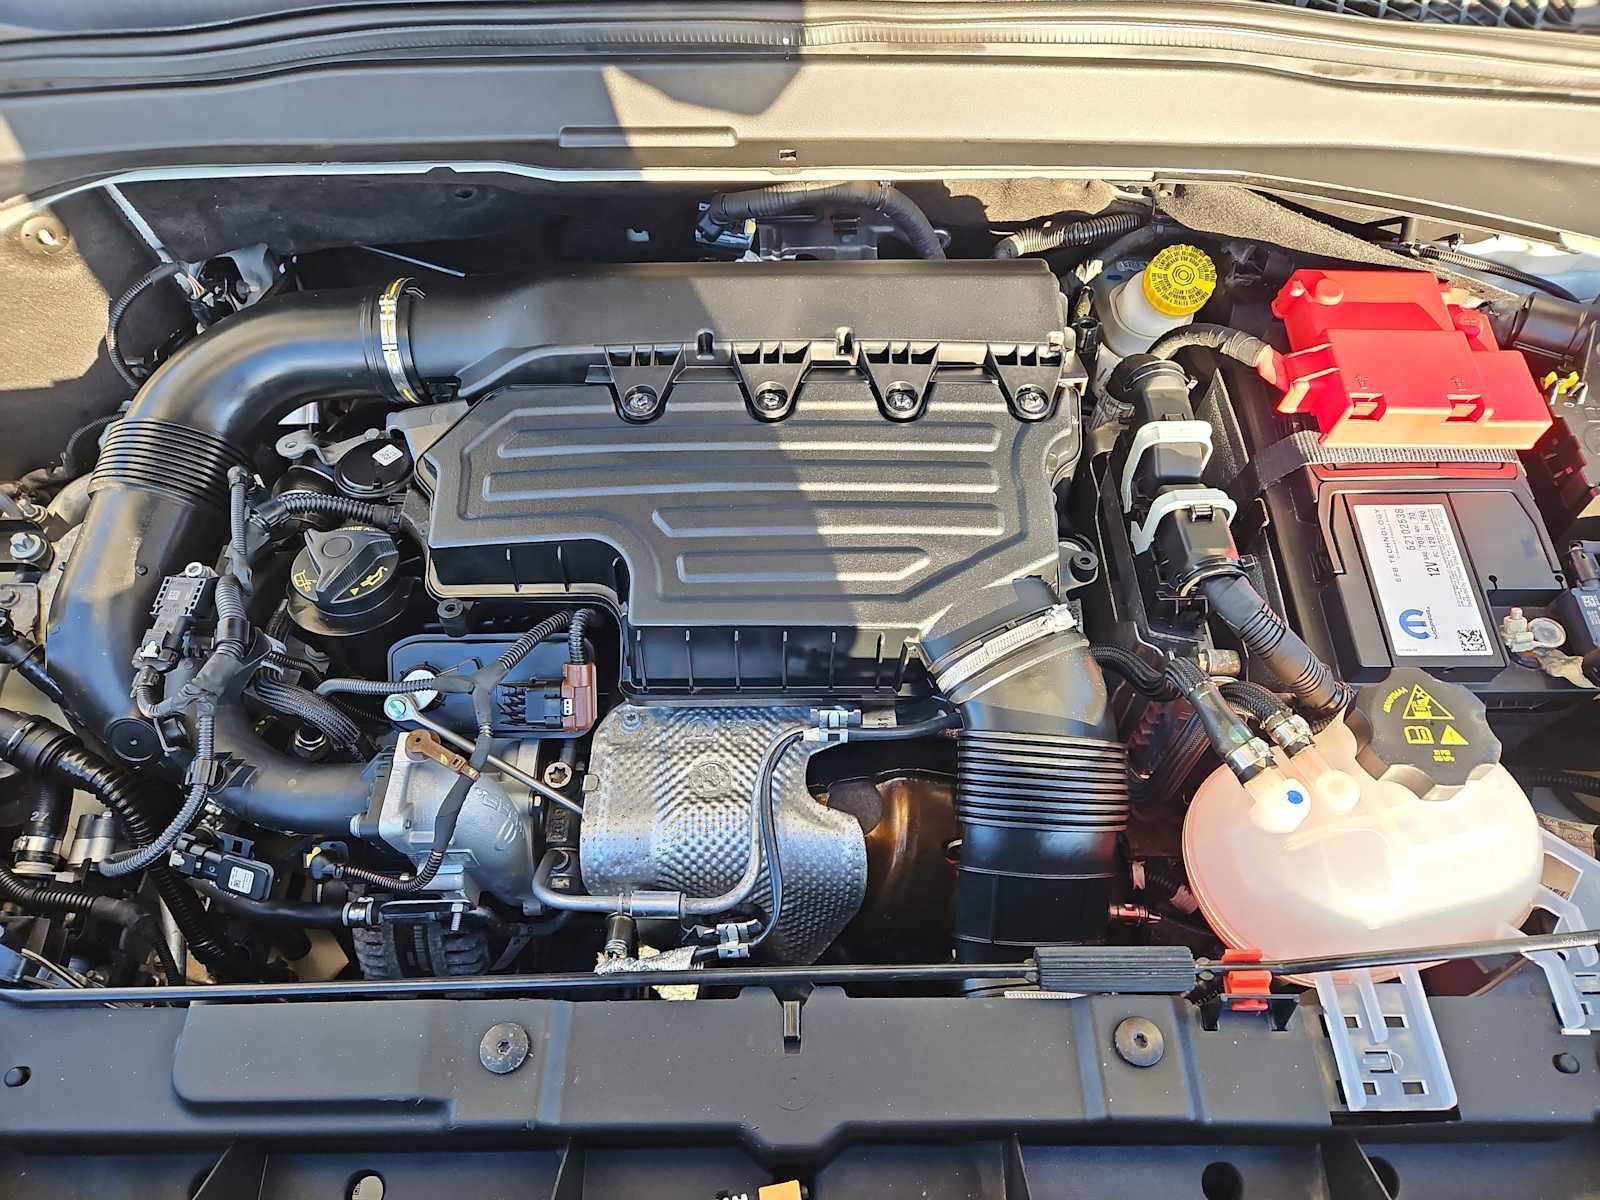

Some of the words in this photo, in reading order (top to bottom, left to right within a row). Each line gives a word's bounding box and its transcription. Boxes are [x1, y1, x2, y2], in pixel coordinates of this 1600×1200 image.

[1376, 509, 1396, 564] TECHNOLOGY
[1393, 568, 1402, 583] EFB
[1424, 561, 1441, 577] 12V
[30, 810, 50, 822] 27
